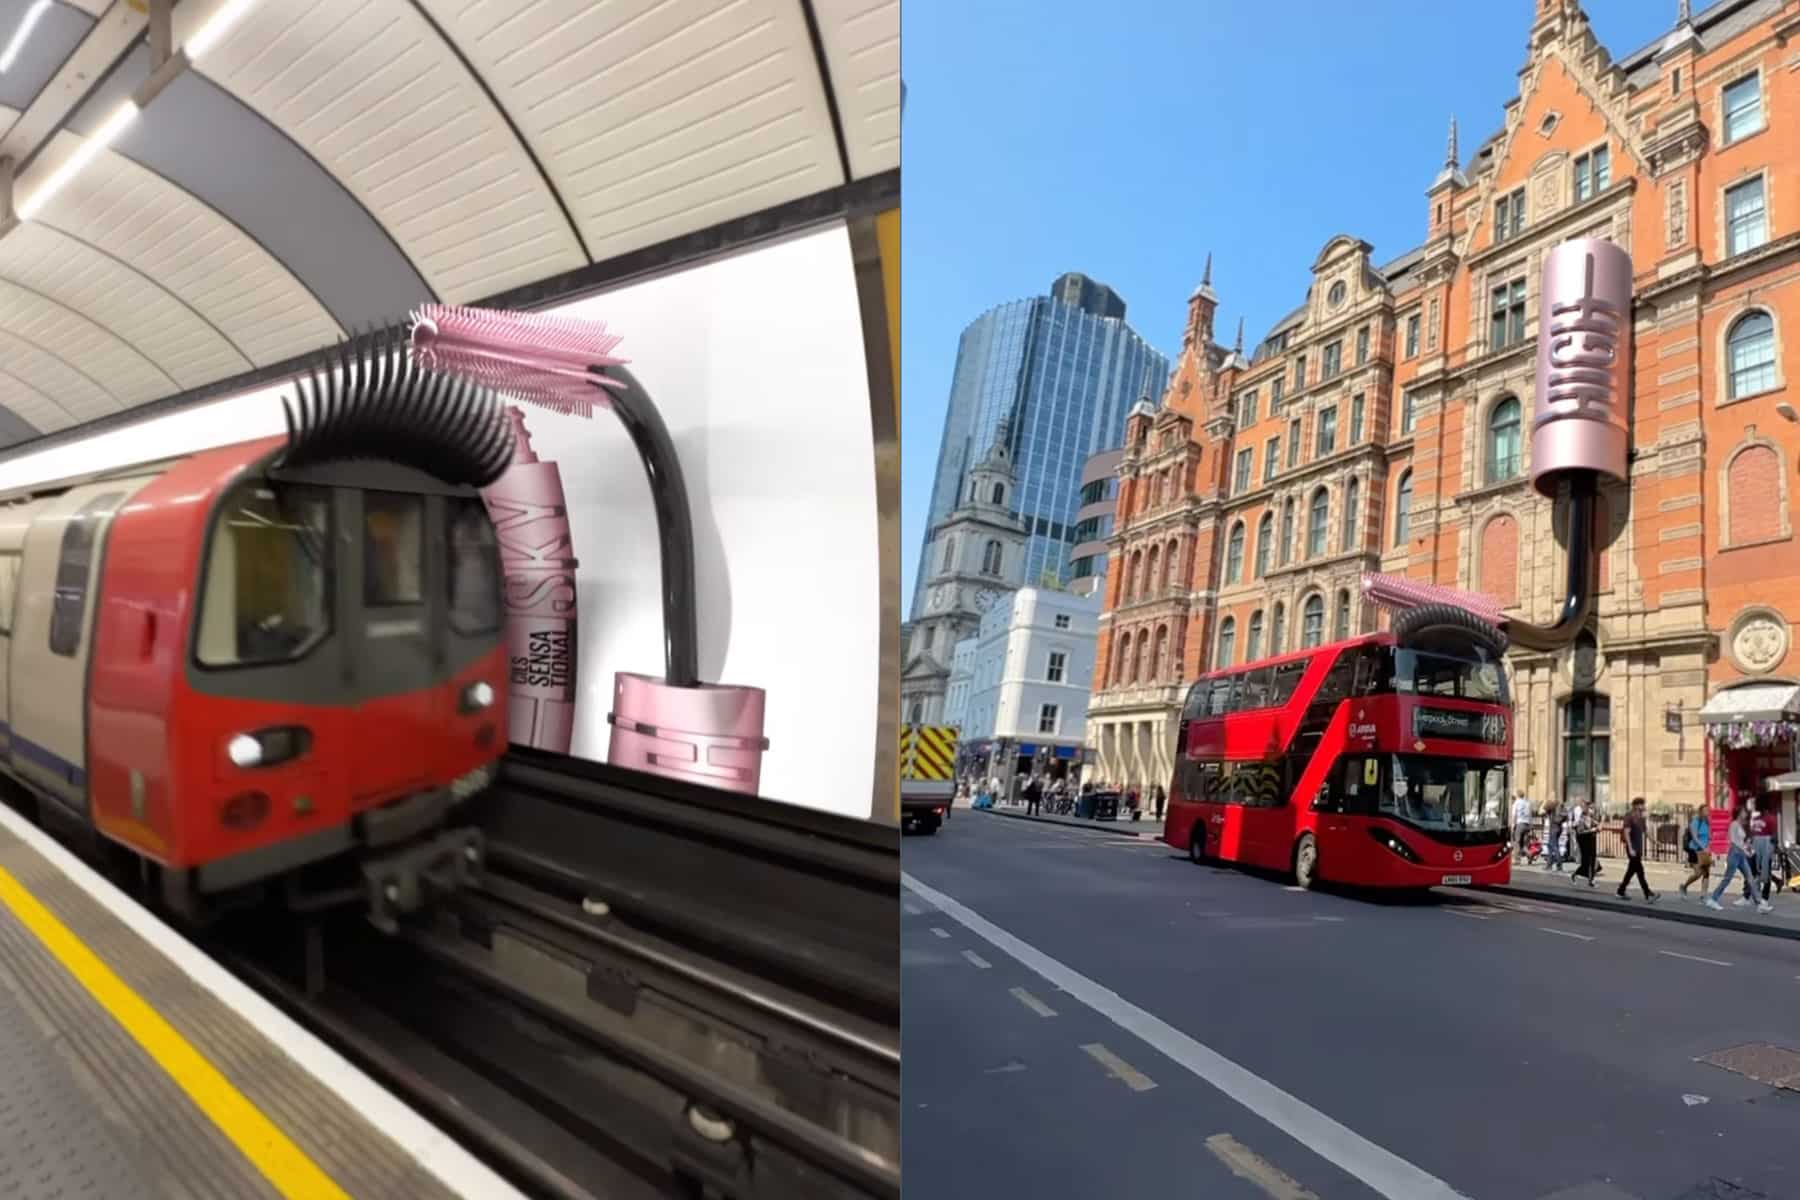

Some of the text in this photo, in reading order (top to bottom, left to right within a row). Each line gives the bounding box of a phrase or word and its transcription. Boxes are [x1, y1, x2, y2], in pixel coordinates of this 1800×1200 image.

[1542, 298, 1618, 424] HIGH
[489, 497, 577, 612] SKY
[529, 631, 552, 688] SENSA
[550, 630, 573, 689] TIONAL
